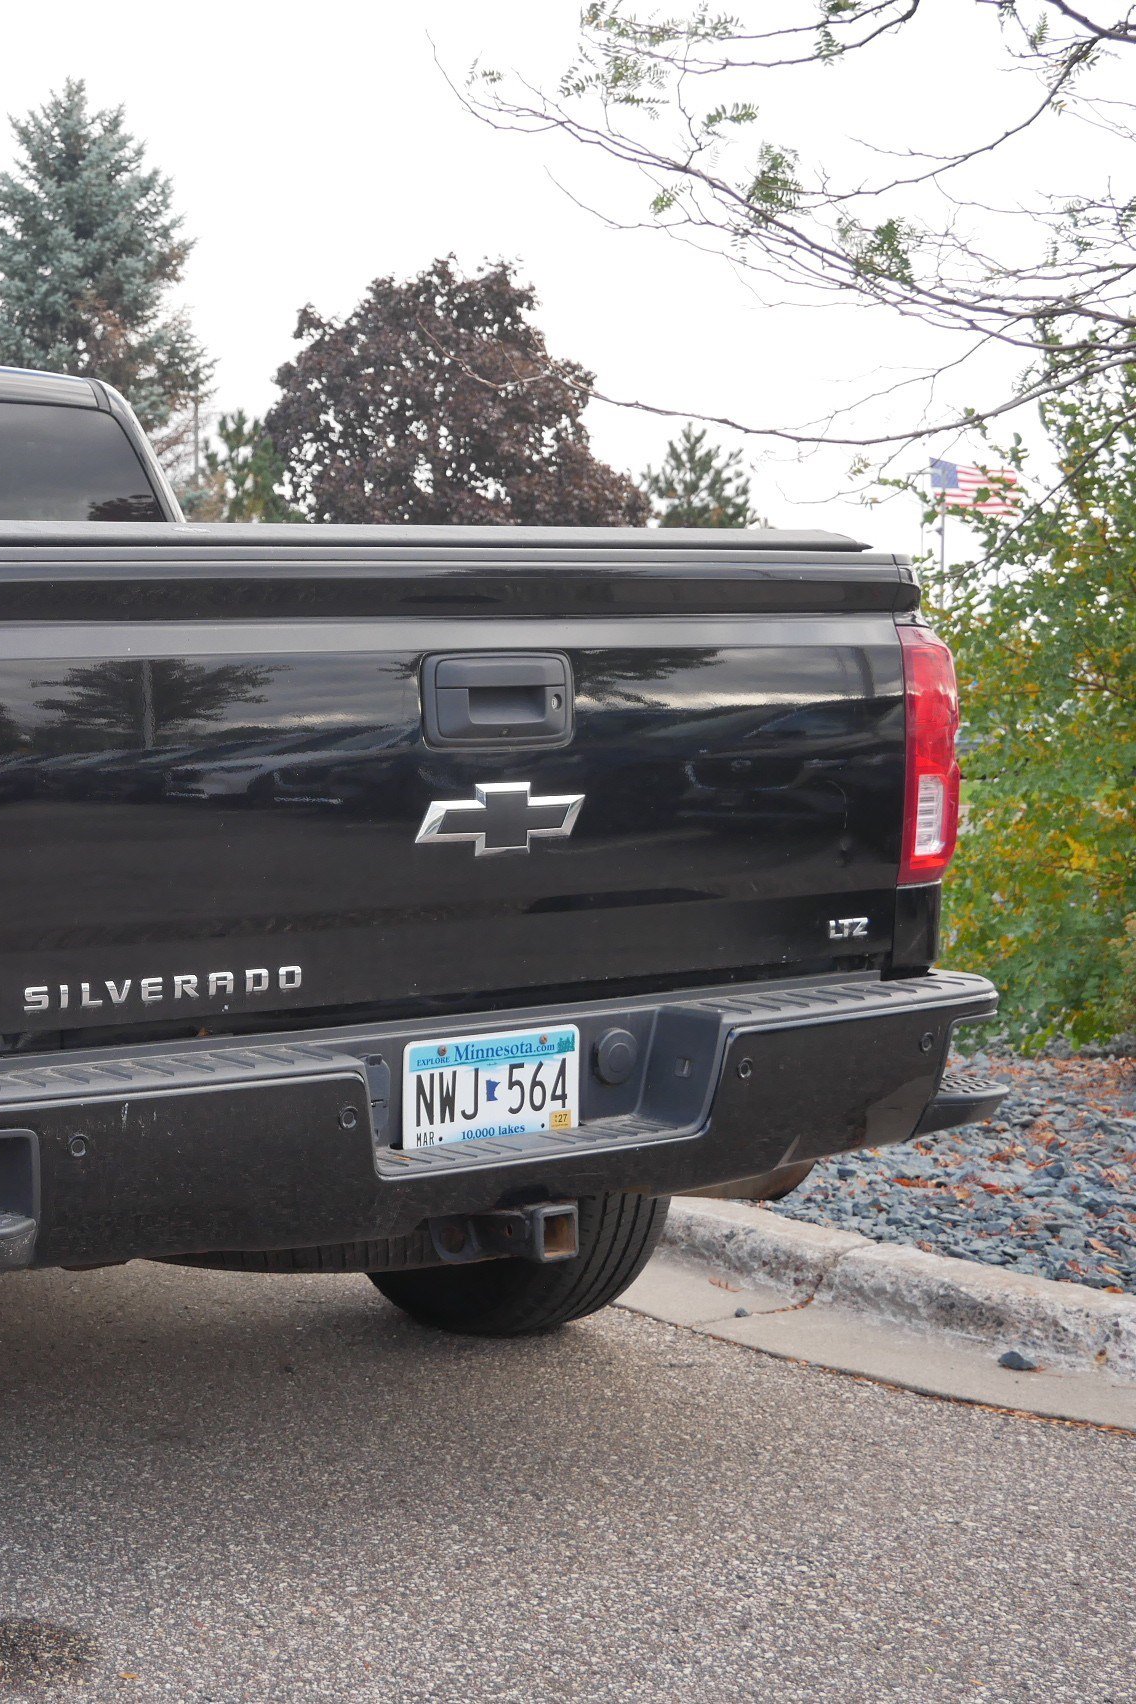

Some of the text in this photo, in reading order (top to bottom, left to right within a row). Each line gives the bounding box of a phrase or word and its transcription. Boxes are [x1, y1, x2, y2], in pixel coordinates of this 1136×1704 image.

[829, 917, 868, 939] LTZ
[23, 965, 302, 1011] SILVERADO
[417, 1040, 555, 1067] EXPLORE Minnesota.com
[416, 1057, 568, 1127] NWJ 564
[558, 1113, 568, 1123] 27
[416, 1131, 435, 1147] MAR
[461, 1124, 525, 1140] 10,000 lakes
